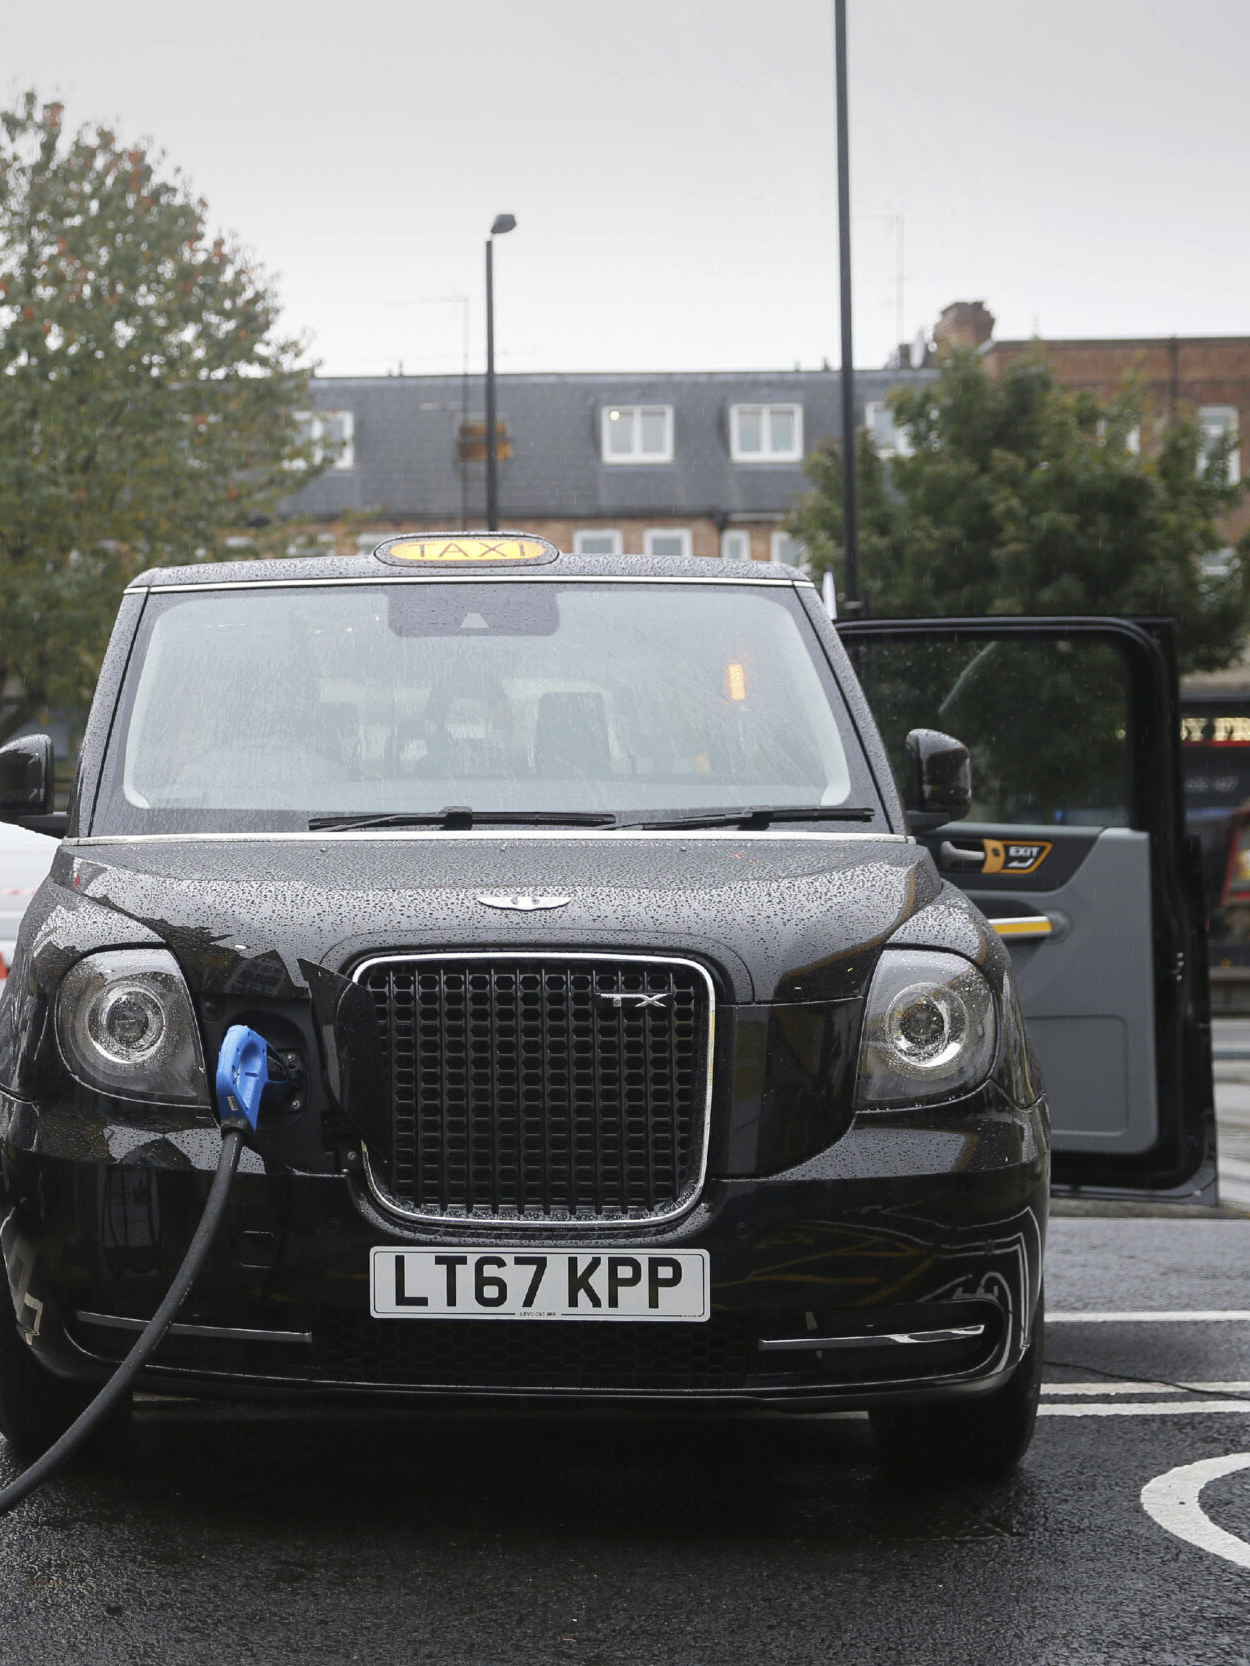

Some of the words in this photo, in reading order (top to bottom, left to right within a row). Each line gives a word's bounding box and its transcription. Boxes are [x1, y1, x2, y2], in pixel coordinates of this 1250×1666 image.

[408, 542, 526, 558] TAXI
[1009, 846, 1040, 857] EXIT
[599, 993, 668, 1008] TX
[394, 1255, 548, 1308] LT67
[568, 1256, 683, 1309] KPP
